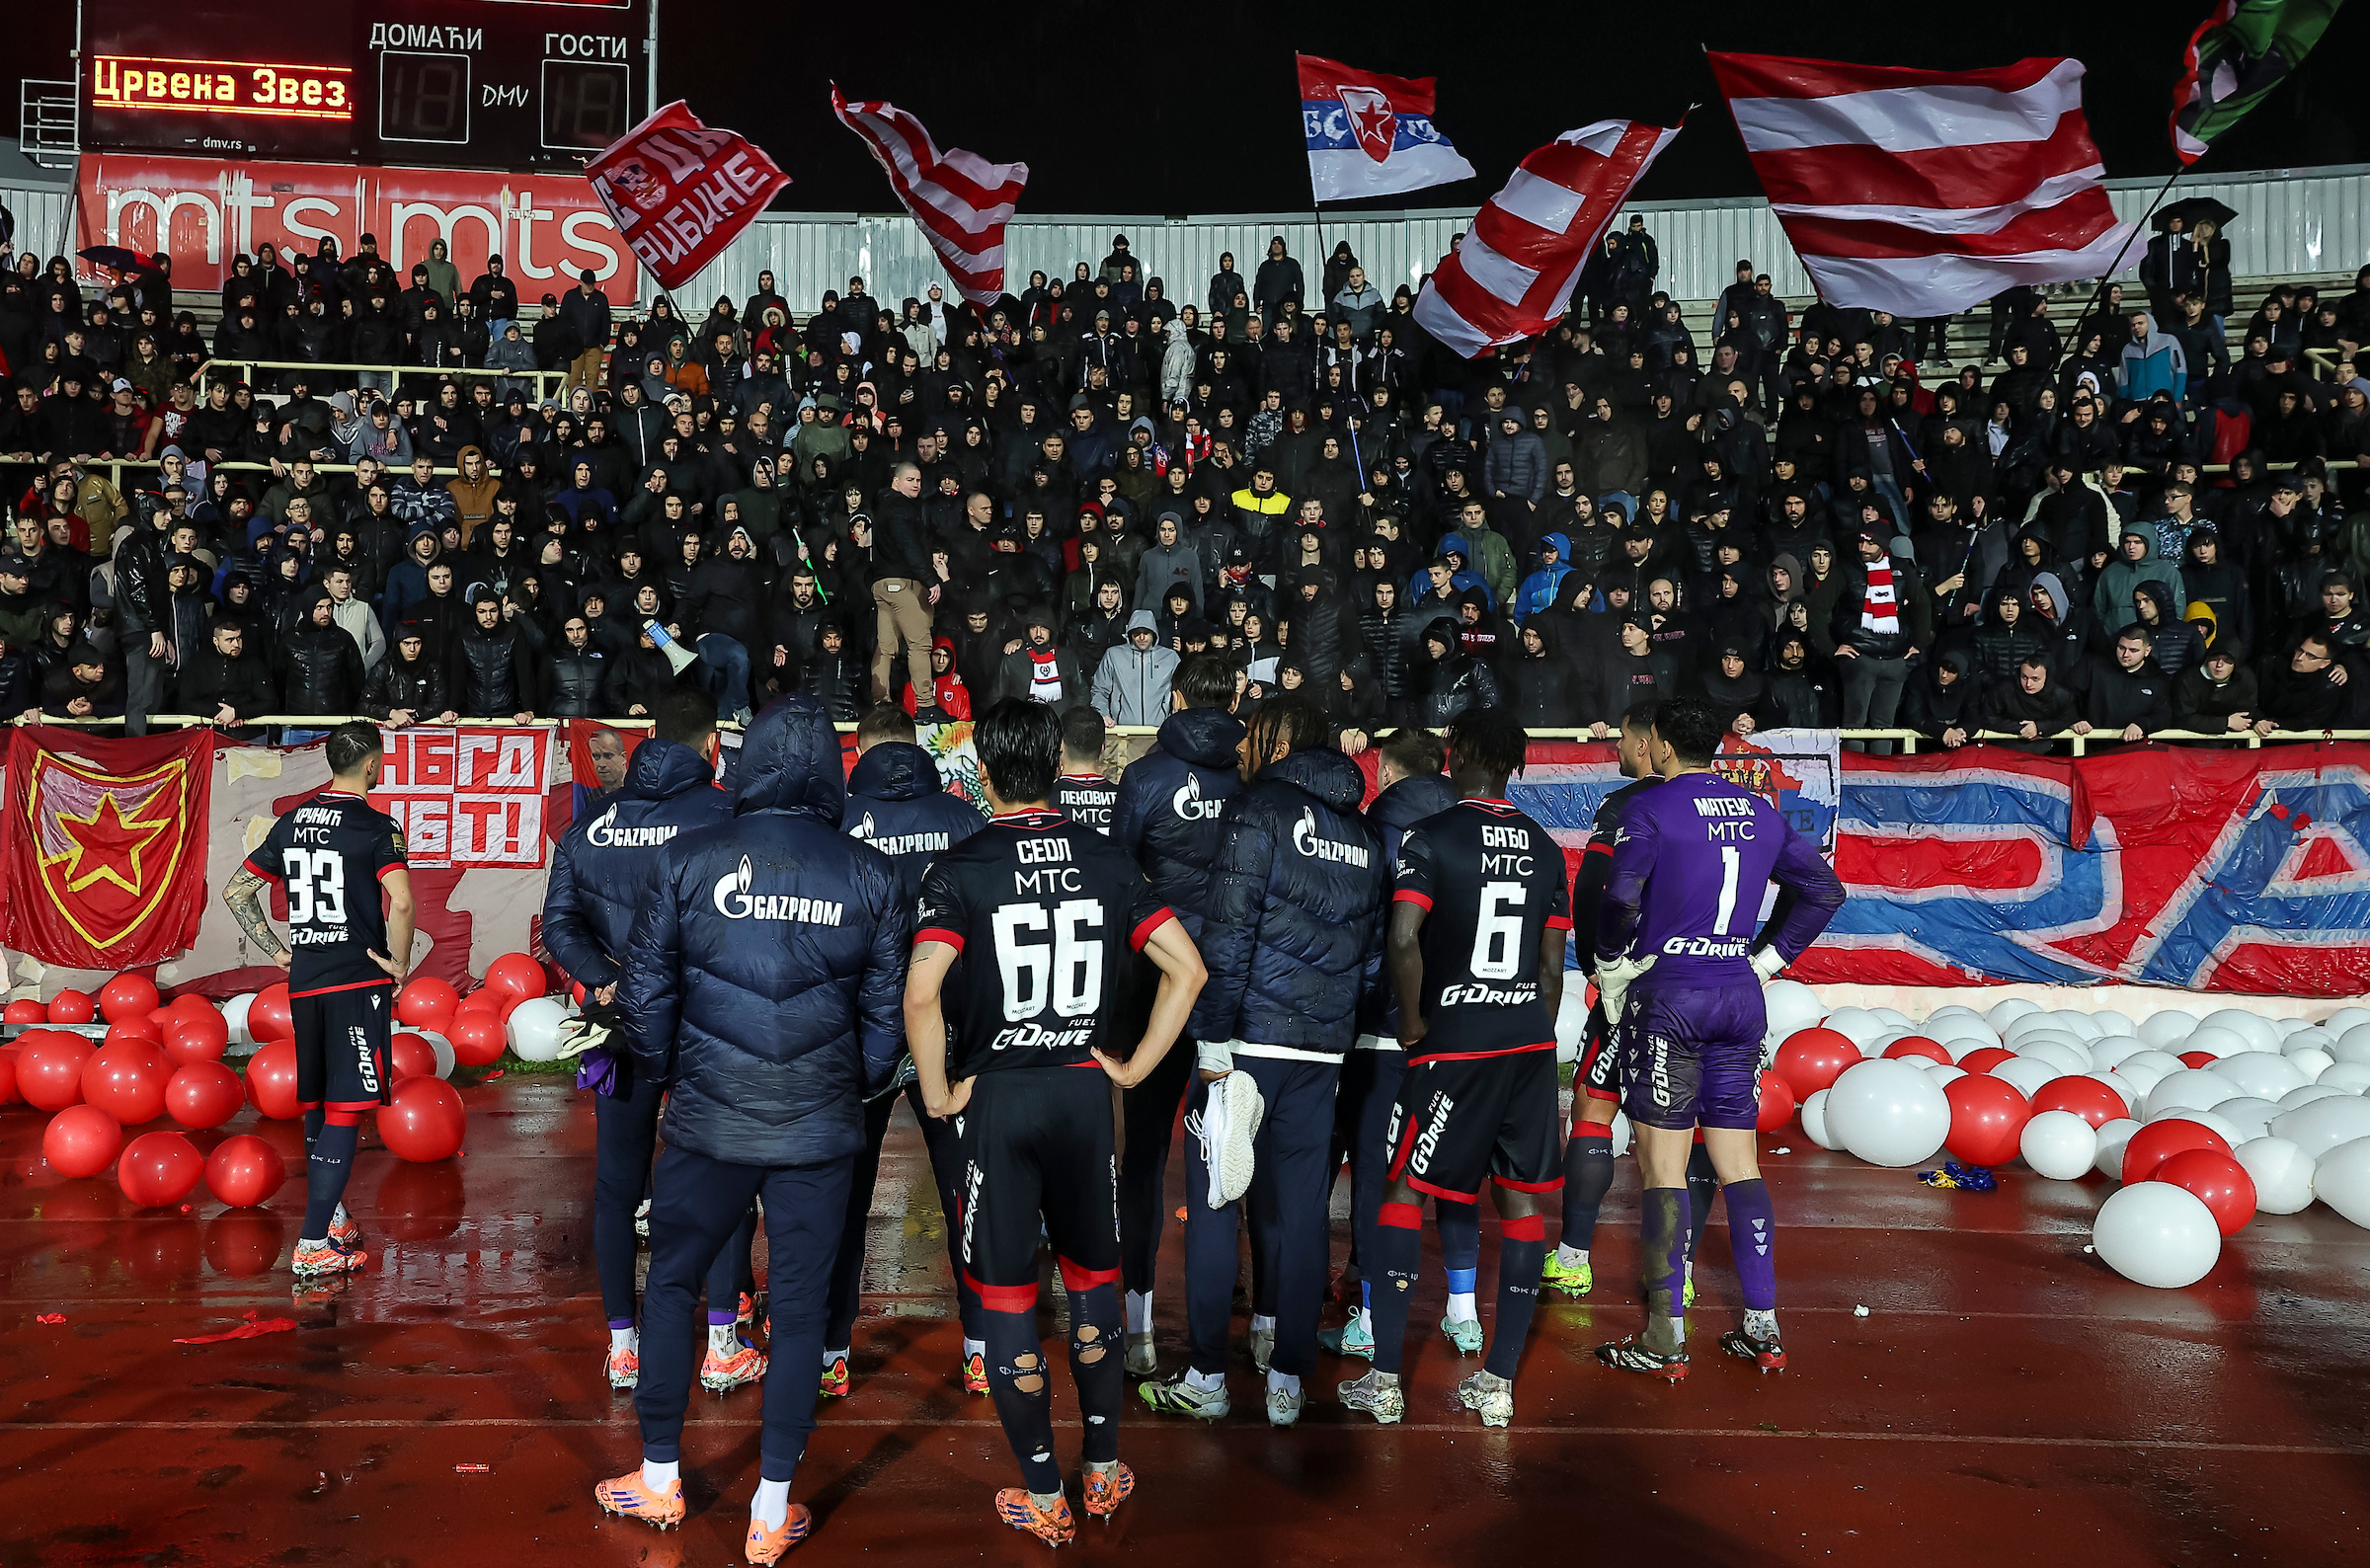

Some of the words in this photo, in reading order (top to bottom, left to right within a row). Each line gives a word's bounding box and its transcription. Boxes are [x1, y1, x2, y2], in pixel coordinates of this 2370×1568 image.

[369, 23, 483, 50] ДОМАЋИ
[545, 33, 627, 58] ГОСТИ
[94, 60, 235, 101] Црвена
[252, 68, 352, 111] Звез
[482, 84, 528, 107] DMV
[202, 136, 242, 150] dmv.rs
[107, 178, 343, 266] mts
[630, 150, 771, 277] РИБИНЕ
[391, 192, 619, 282] mts
[292, 807, 343, 827] КРУНИЋ
[1693, 797, 1756, 818] МАТЕУС
[613, 824, 678, 847] GAZPROM
[878, 831, 949, 856] GAZPROM
[1016, 837, 1073, 865] СЕОЛ
[1317, 838, 1370, 870] GAZPROM
[282, 847, 348, 924] 33
[1713, 845, 1740, 936] 1
[752, 897, 843, 927] GAZPROM
[1469, 881, 1528, 980] 6
[1730, 936, 1750, 945] FUEL
[991, 898, 1105, 1023] 66
[1068, 1018, 1096, 1028] FUEL
[1427, 1089, 1443, 1114] FUEL
